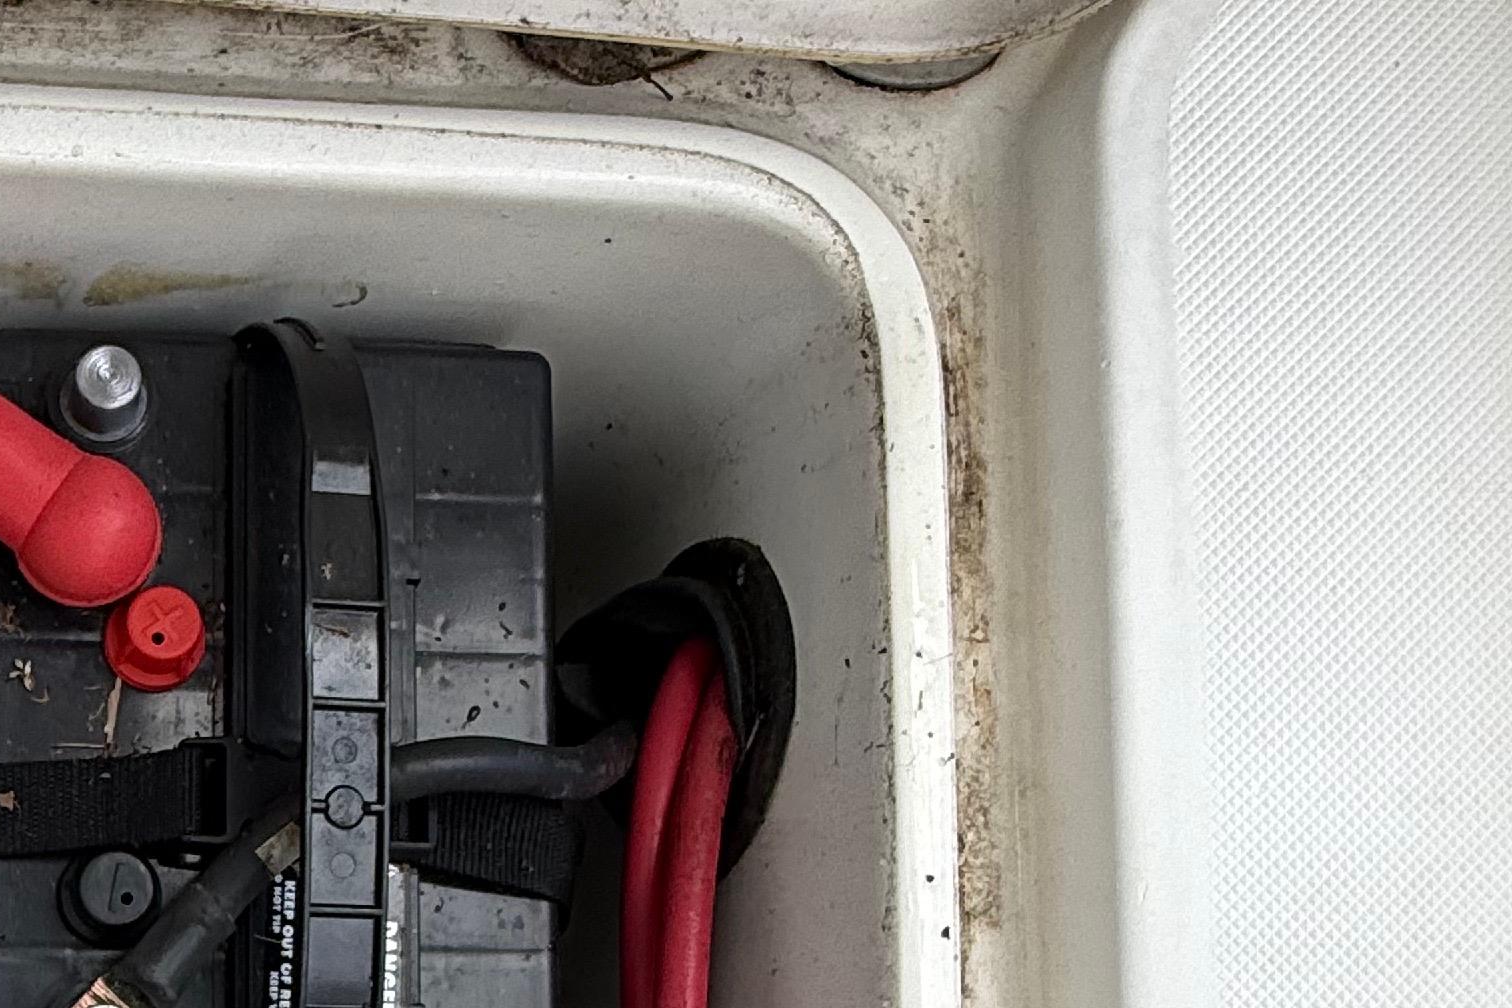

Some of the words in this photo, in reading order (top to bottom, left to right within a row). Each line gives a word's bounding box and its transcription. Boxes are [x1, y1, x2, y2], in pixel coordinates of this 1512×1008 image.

[272, 886, 283, 912] NOT
[282, 880, 296, 920] KEEP
[272, 914, 282, 934] TIP
[280, 924, 294, 959] OUT
[269, 970, 280, 1001] KEEP
[280, 962, 292, 985] OF
